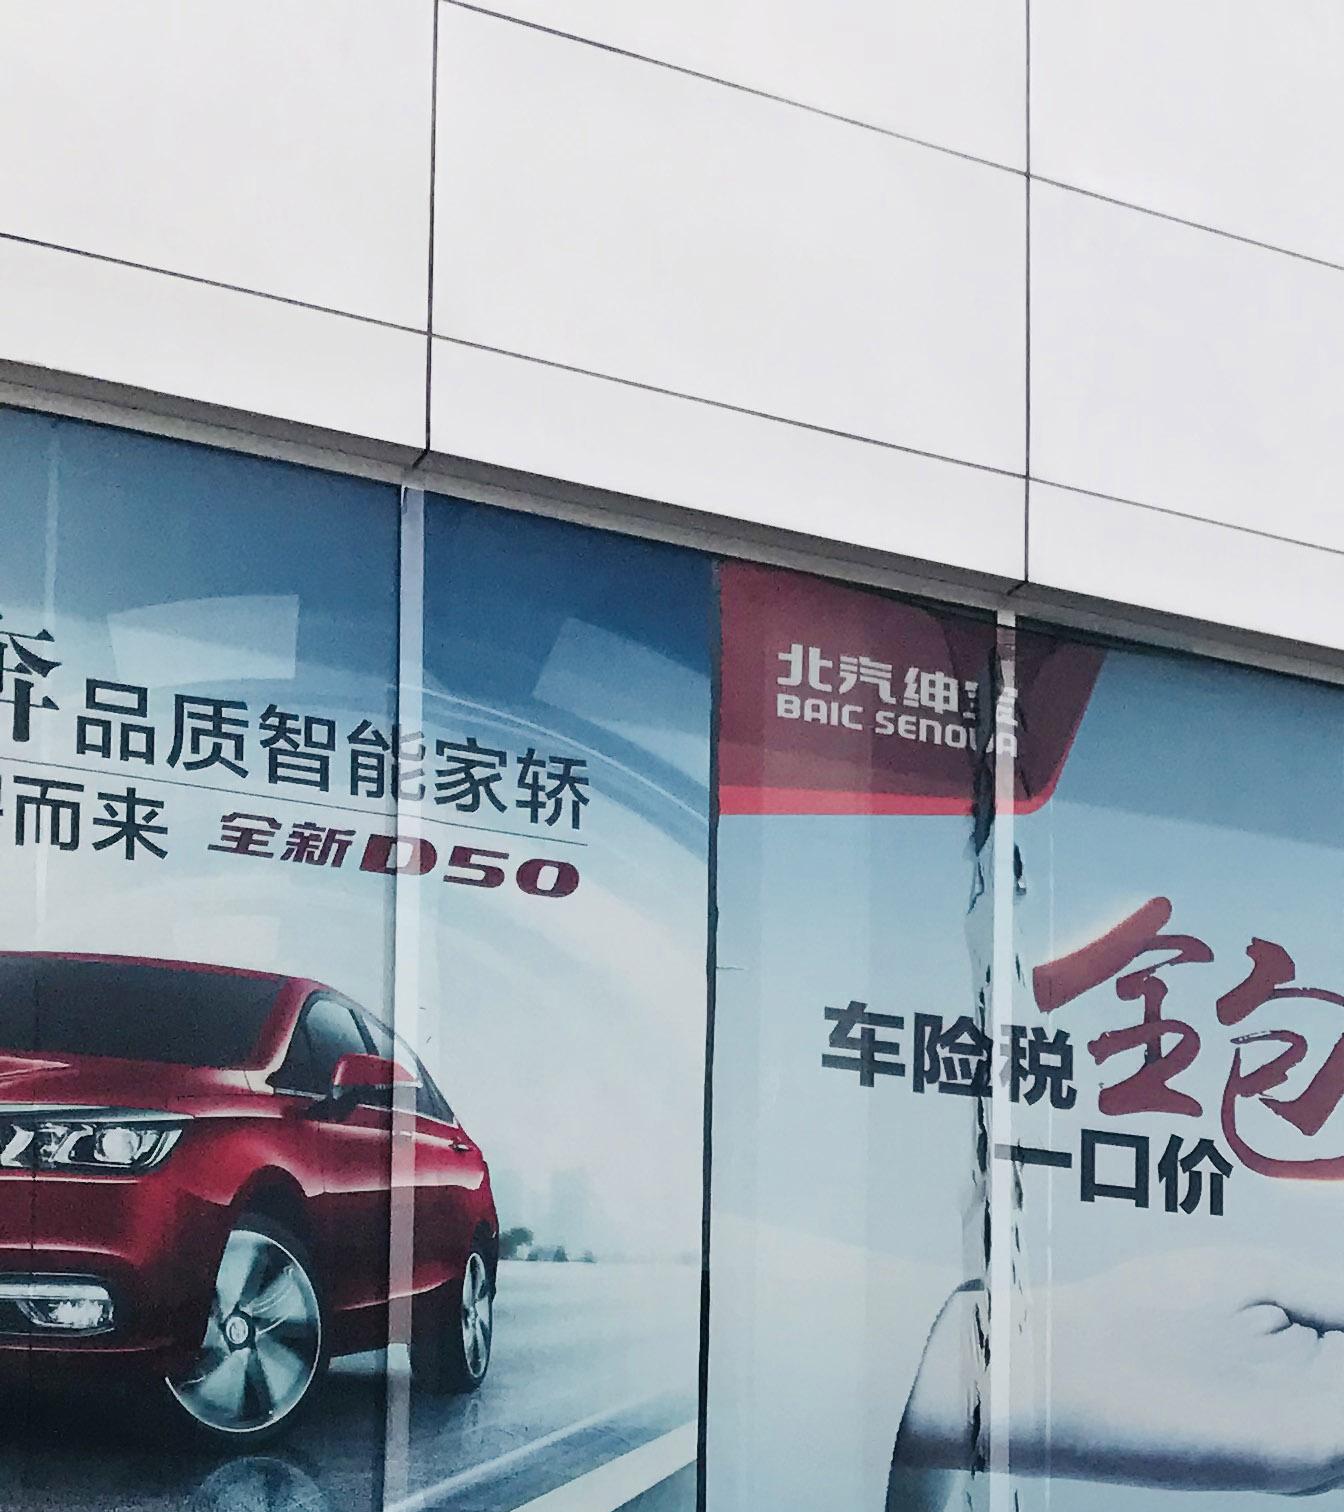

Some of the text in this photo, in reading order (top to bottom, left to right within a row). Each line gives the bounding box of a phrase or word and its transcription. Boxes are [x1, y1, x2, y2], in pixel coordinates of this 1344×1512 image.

[76, 678, 591, 830] 品质智能家轿
[777, 692, 864, 731] BAIC
[0, 773, 168, 860] 而来
[994, 1128, 1234, 1216] 一口价
